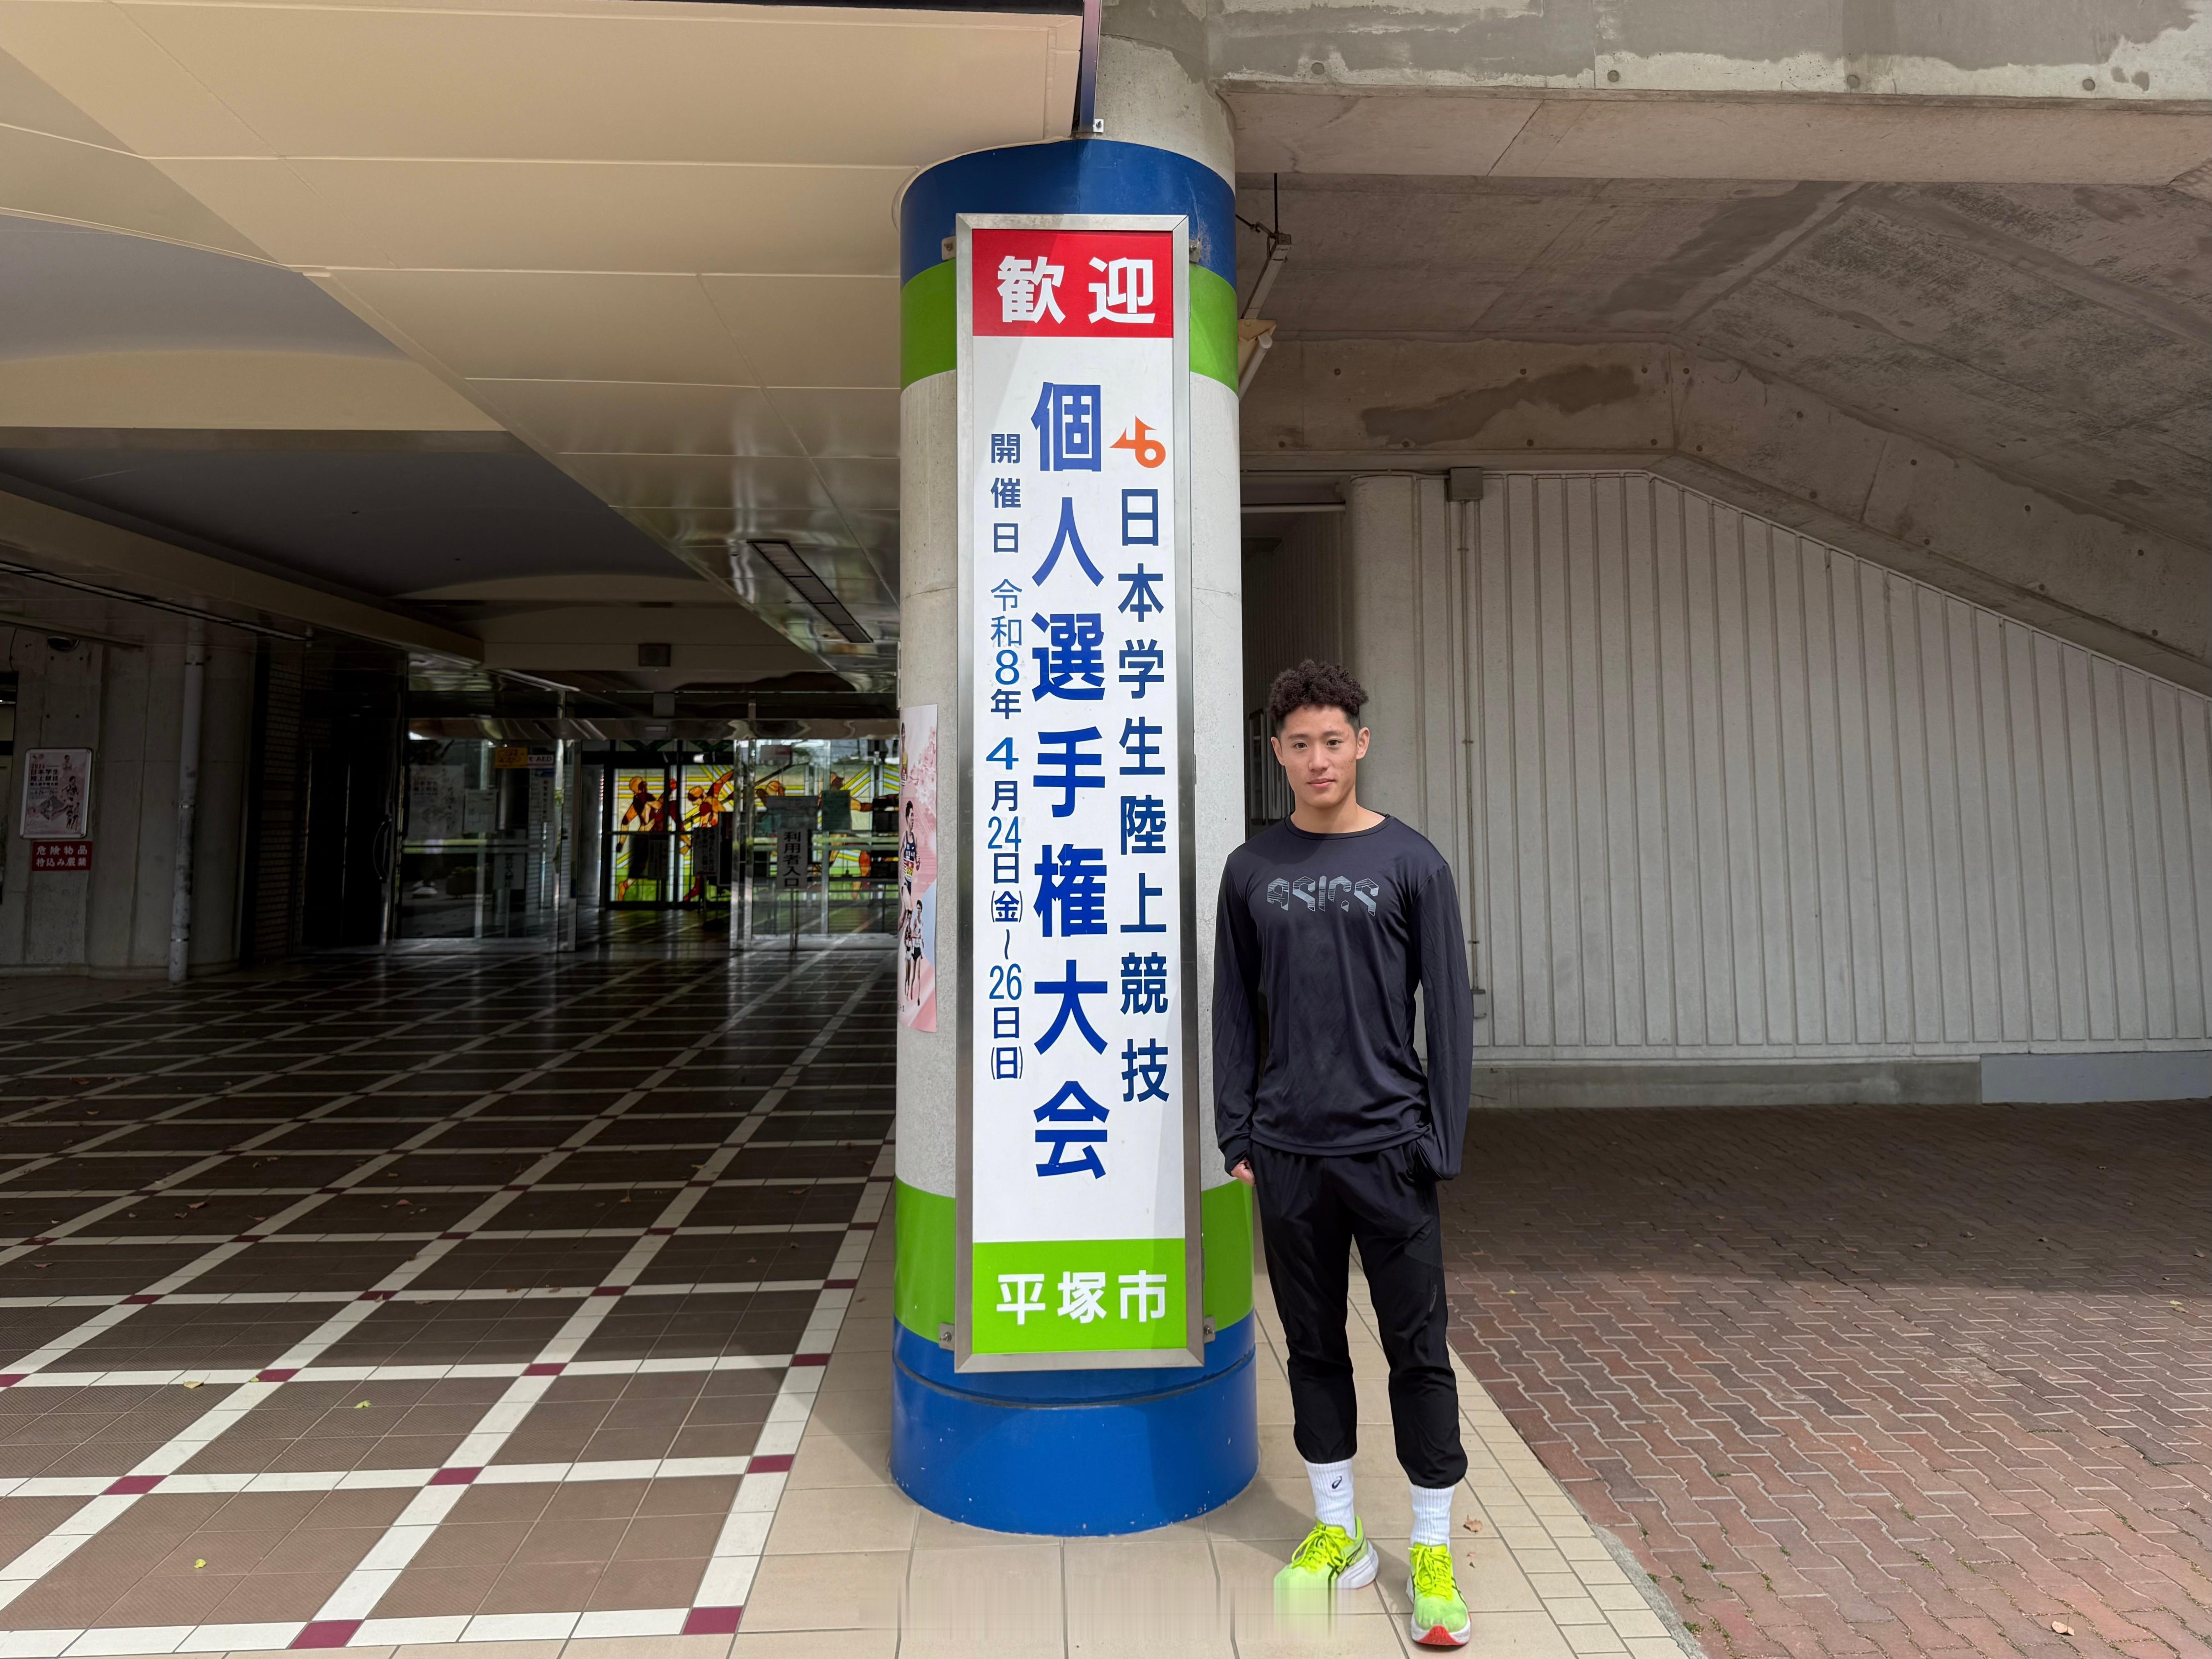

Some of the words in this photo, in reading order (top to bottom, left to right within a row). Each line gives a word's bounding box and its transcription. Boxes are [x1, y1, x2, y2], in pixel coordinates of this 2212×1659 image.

[997, 256, 1155, 323] 歓迎
[1031, 382, 1110, 1179] 個人選手権大会
[1118, 489, 1169, 1102] 日本学生陸上競技
[36, 845, 87, 855] 危険物品
[783, 831, 802, 887] 利用者入口
[996, 1270, 1167, 1325] 平塚市
